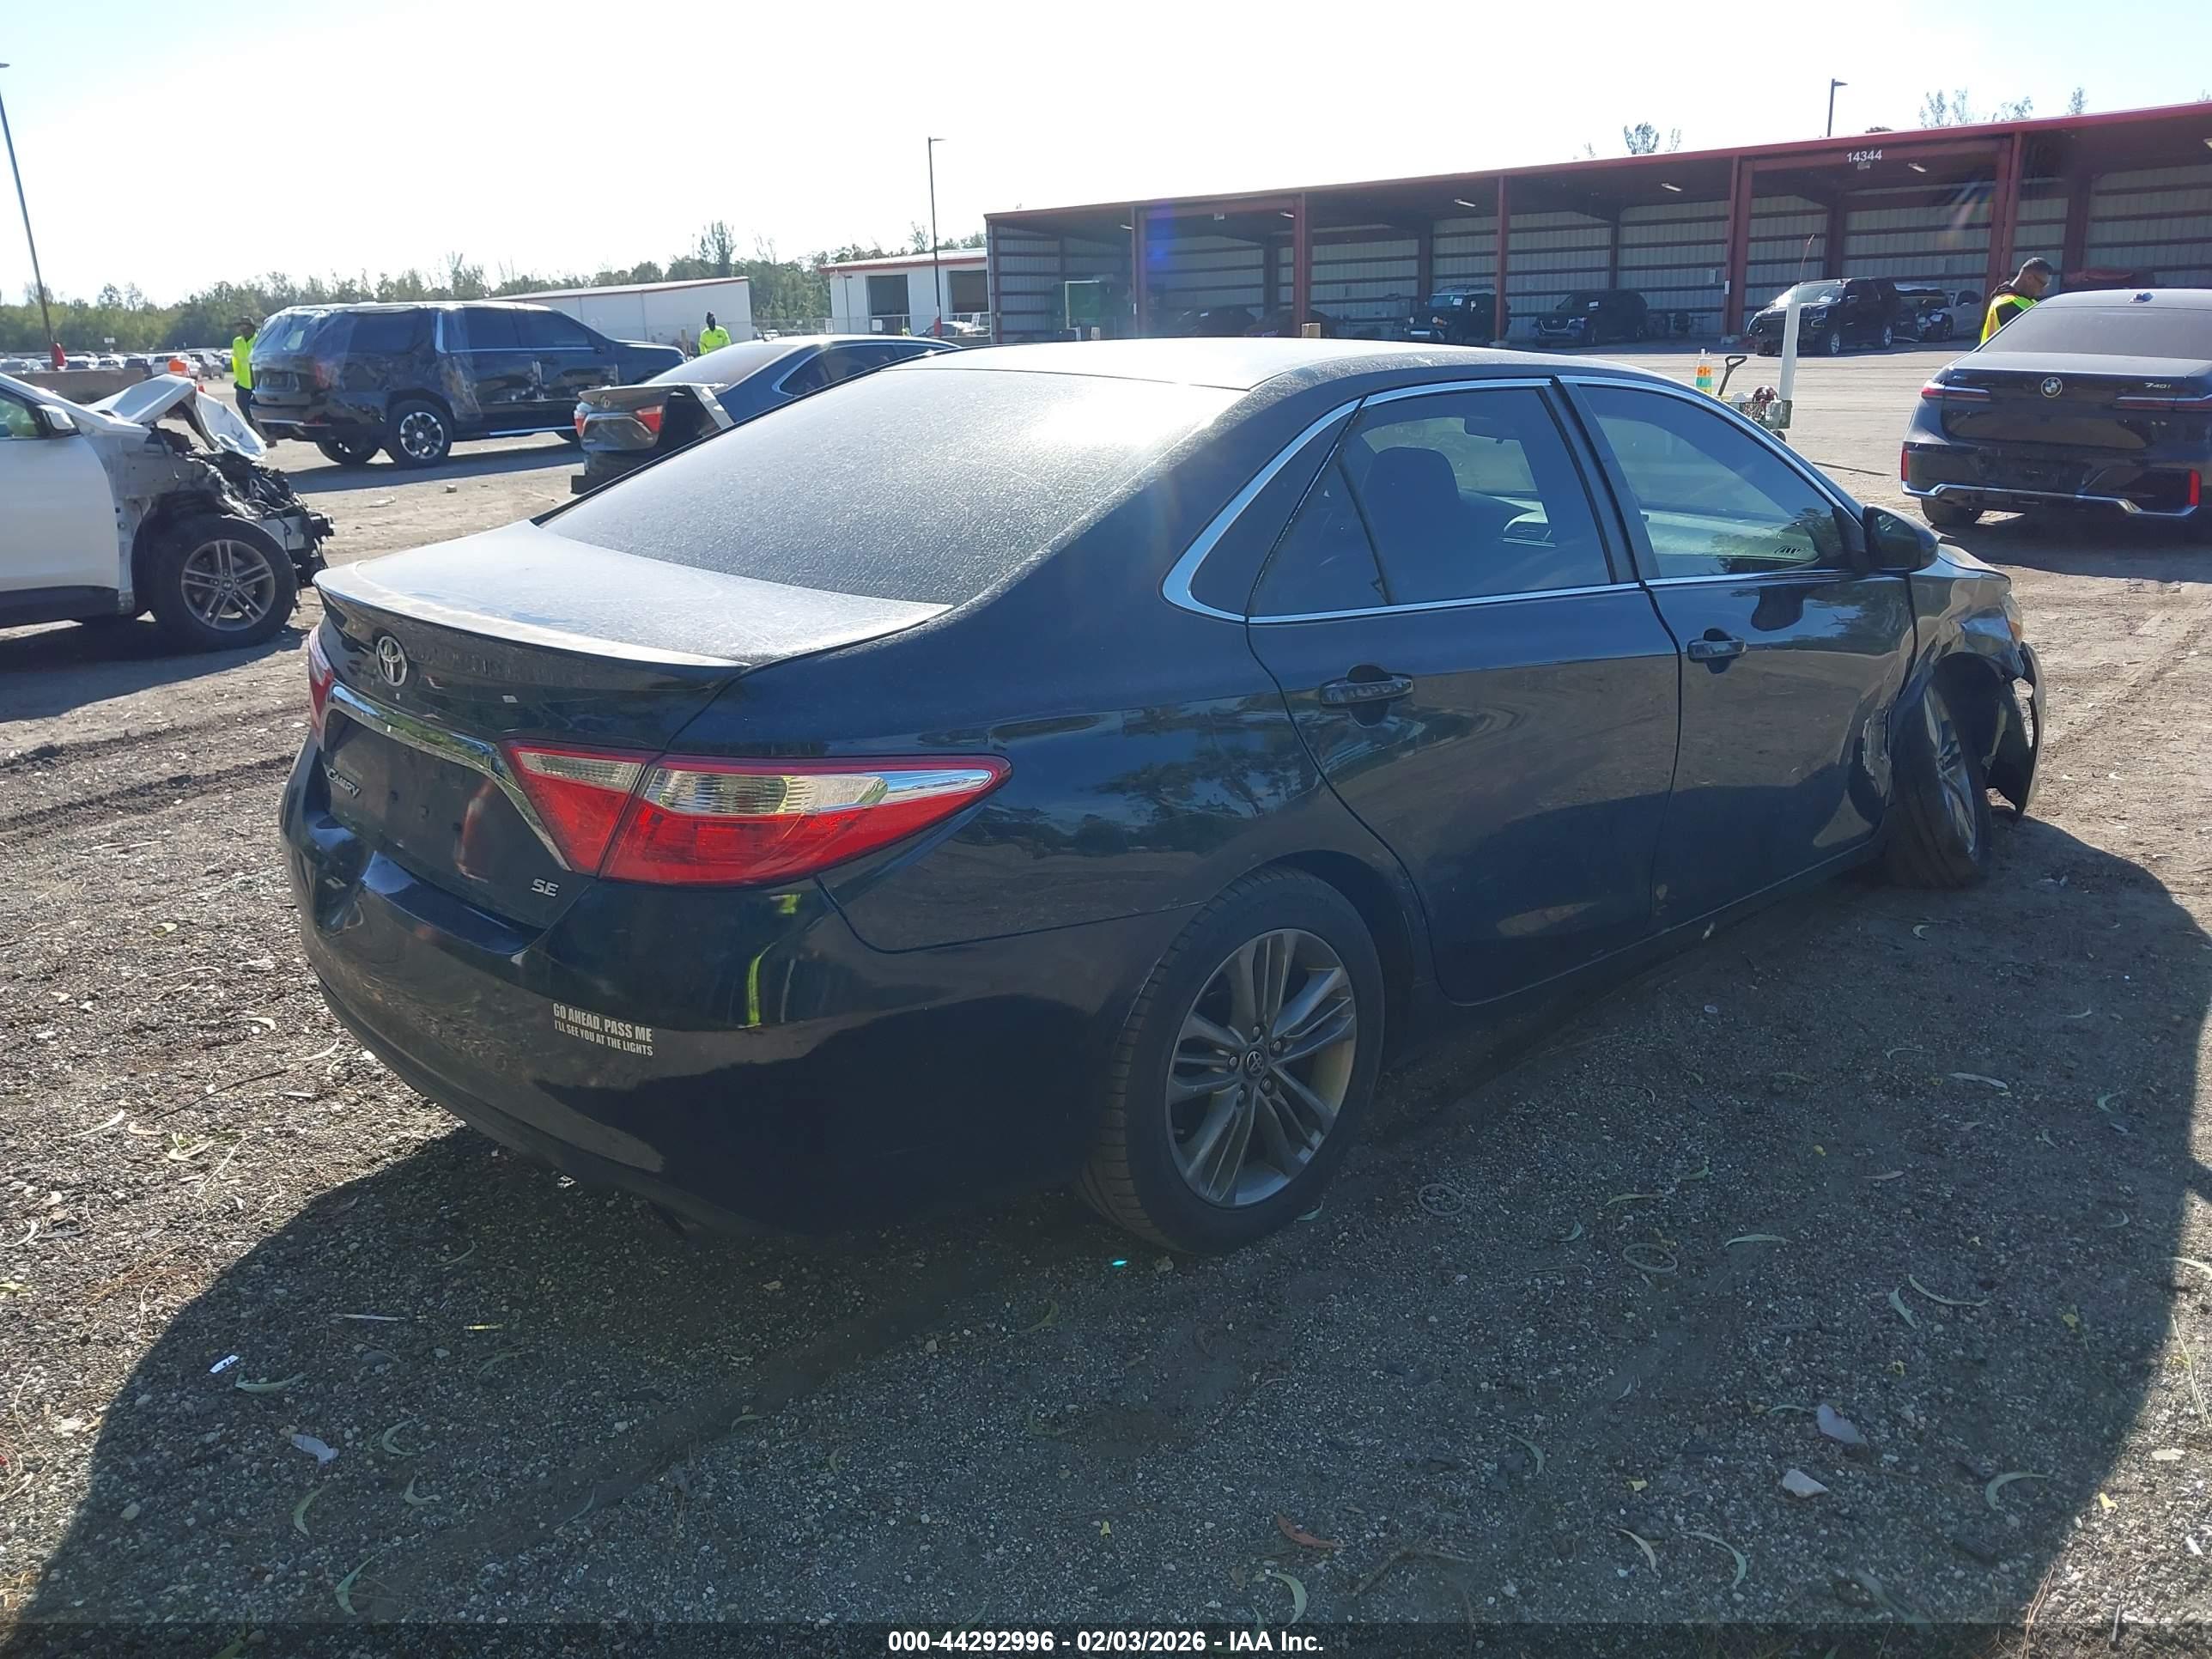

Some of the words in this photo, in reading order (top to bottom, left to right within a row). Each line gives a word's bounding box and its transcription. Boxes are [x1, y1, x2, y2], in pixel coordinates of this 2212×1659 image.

[1846, 149, 1882, 162] 14344
[531, 878, 559, 897] SE
[553, 1003, 567, 1019] GO
[605, 1018, 633, 1038] PASS
[635, 1025, 653, 1042] ME
[555, 1019, 566, 1033] I'LL
[567, 1024, 579, 1036] SEE
[580, 1029, 595, 1042] YOU
[596, 1033, 605, 1045] AT
[605, 1036, 621, 1049] THE
[623, 1040, 653, 1056] LIGHTS
